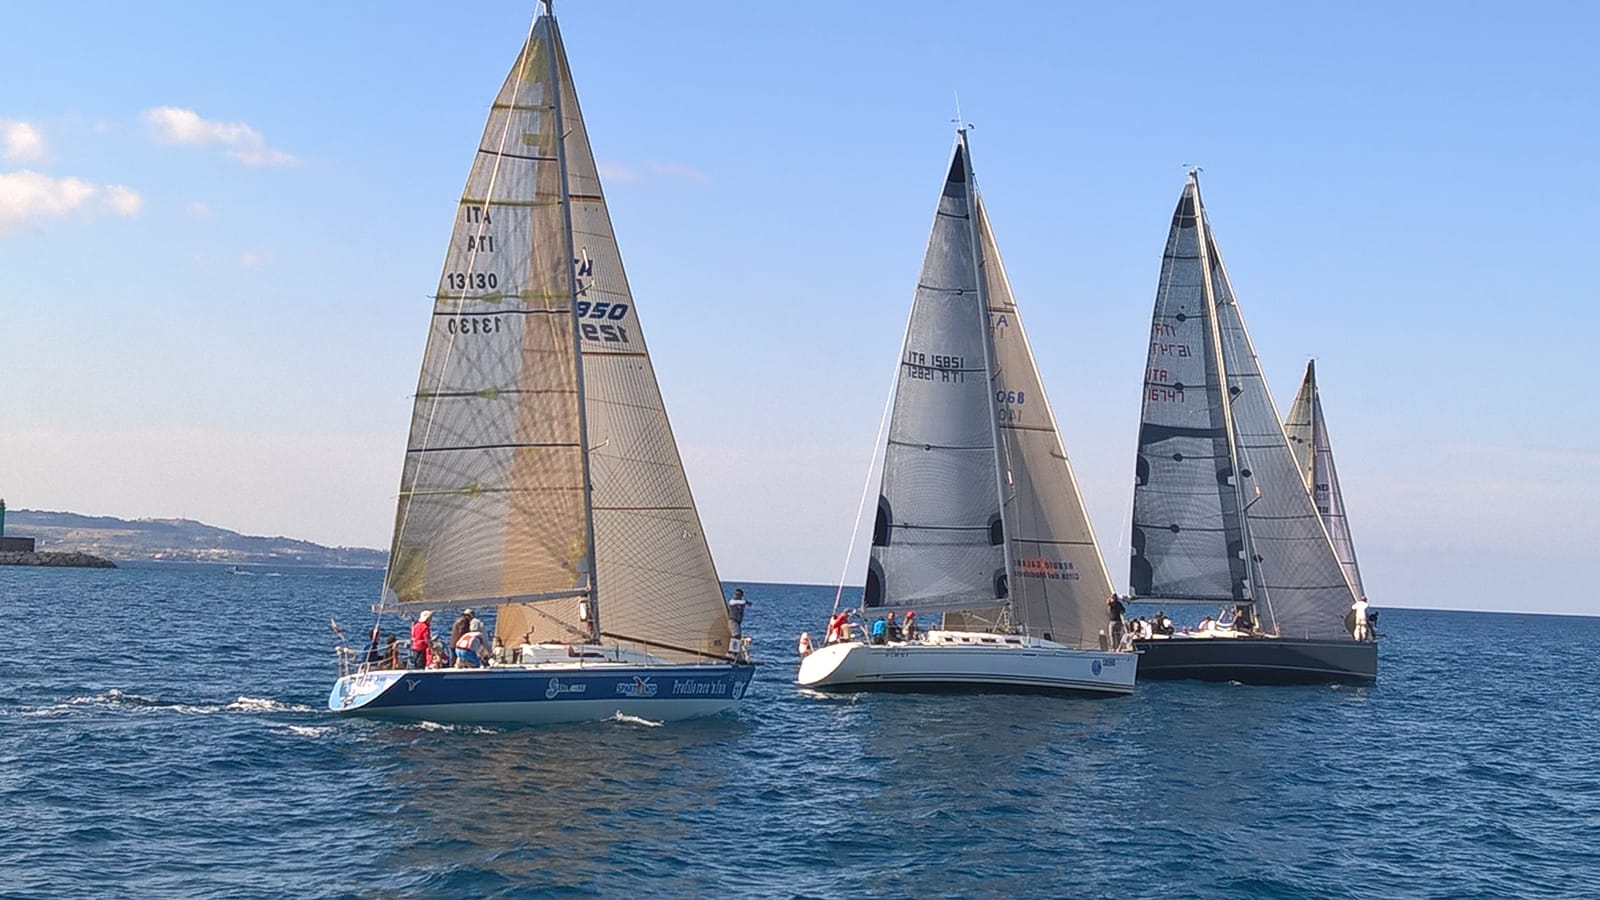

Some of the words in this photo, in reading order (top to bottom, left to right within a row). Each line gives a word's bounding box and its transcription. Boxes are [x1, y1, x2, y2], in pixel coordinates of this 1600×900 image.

[466, 206, 492, 225] ITA
[447, 272, 498, 290] 13130
[908, 351, 926, 365] ITA
[1147, 368, 1168, 382] ITA
